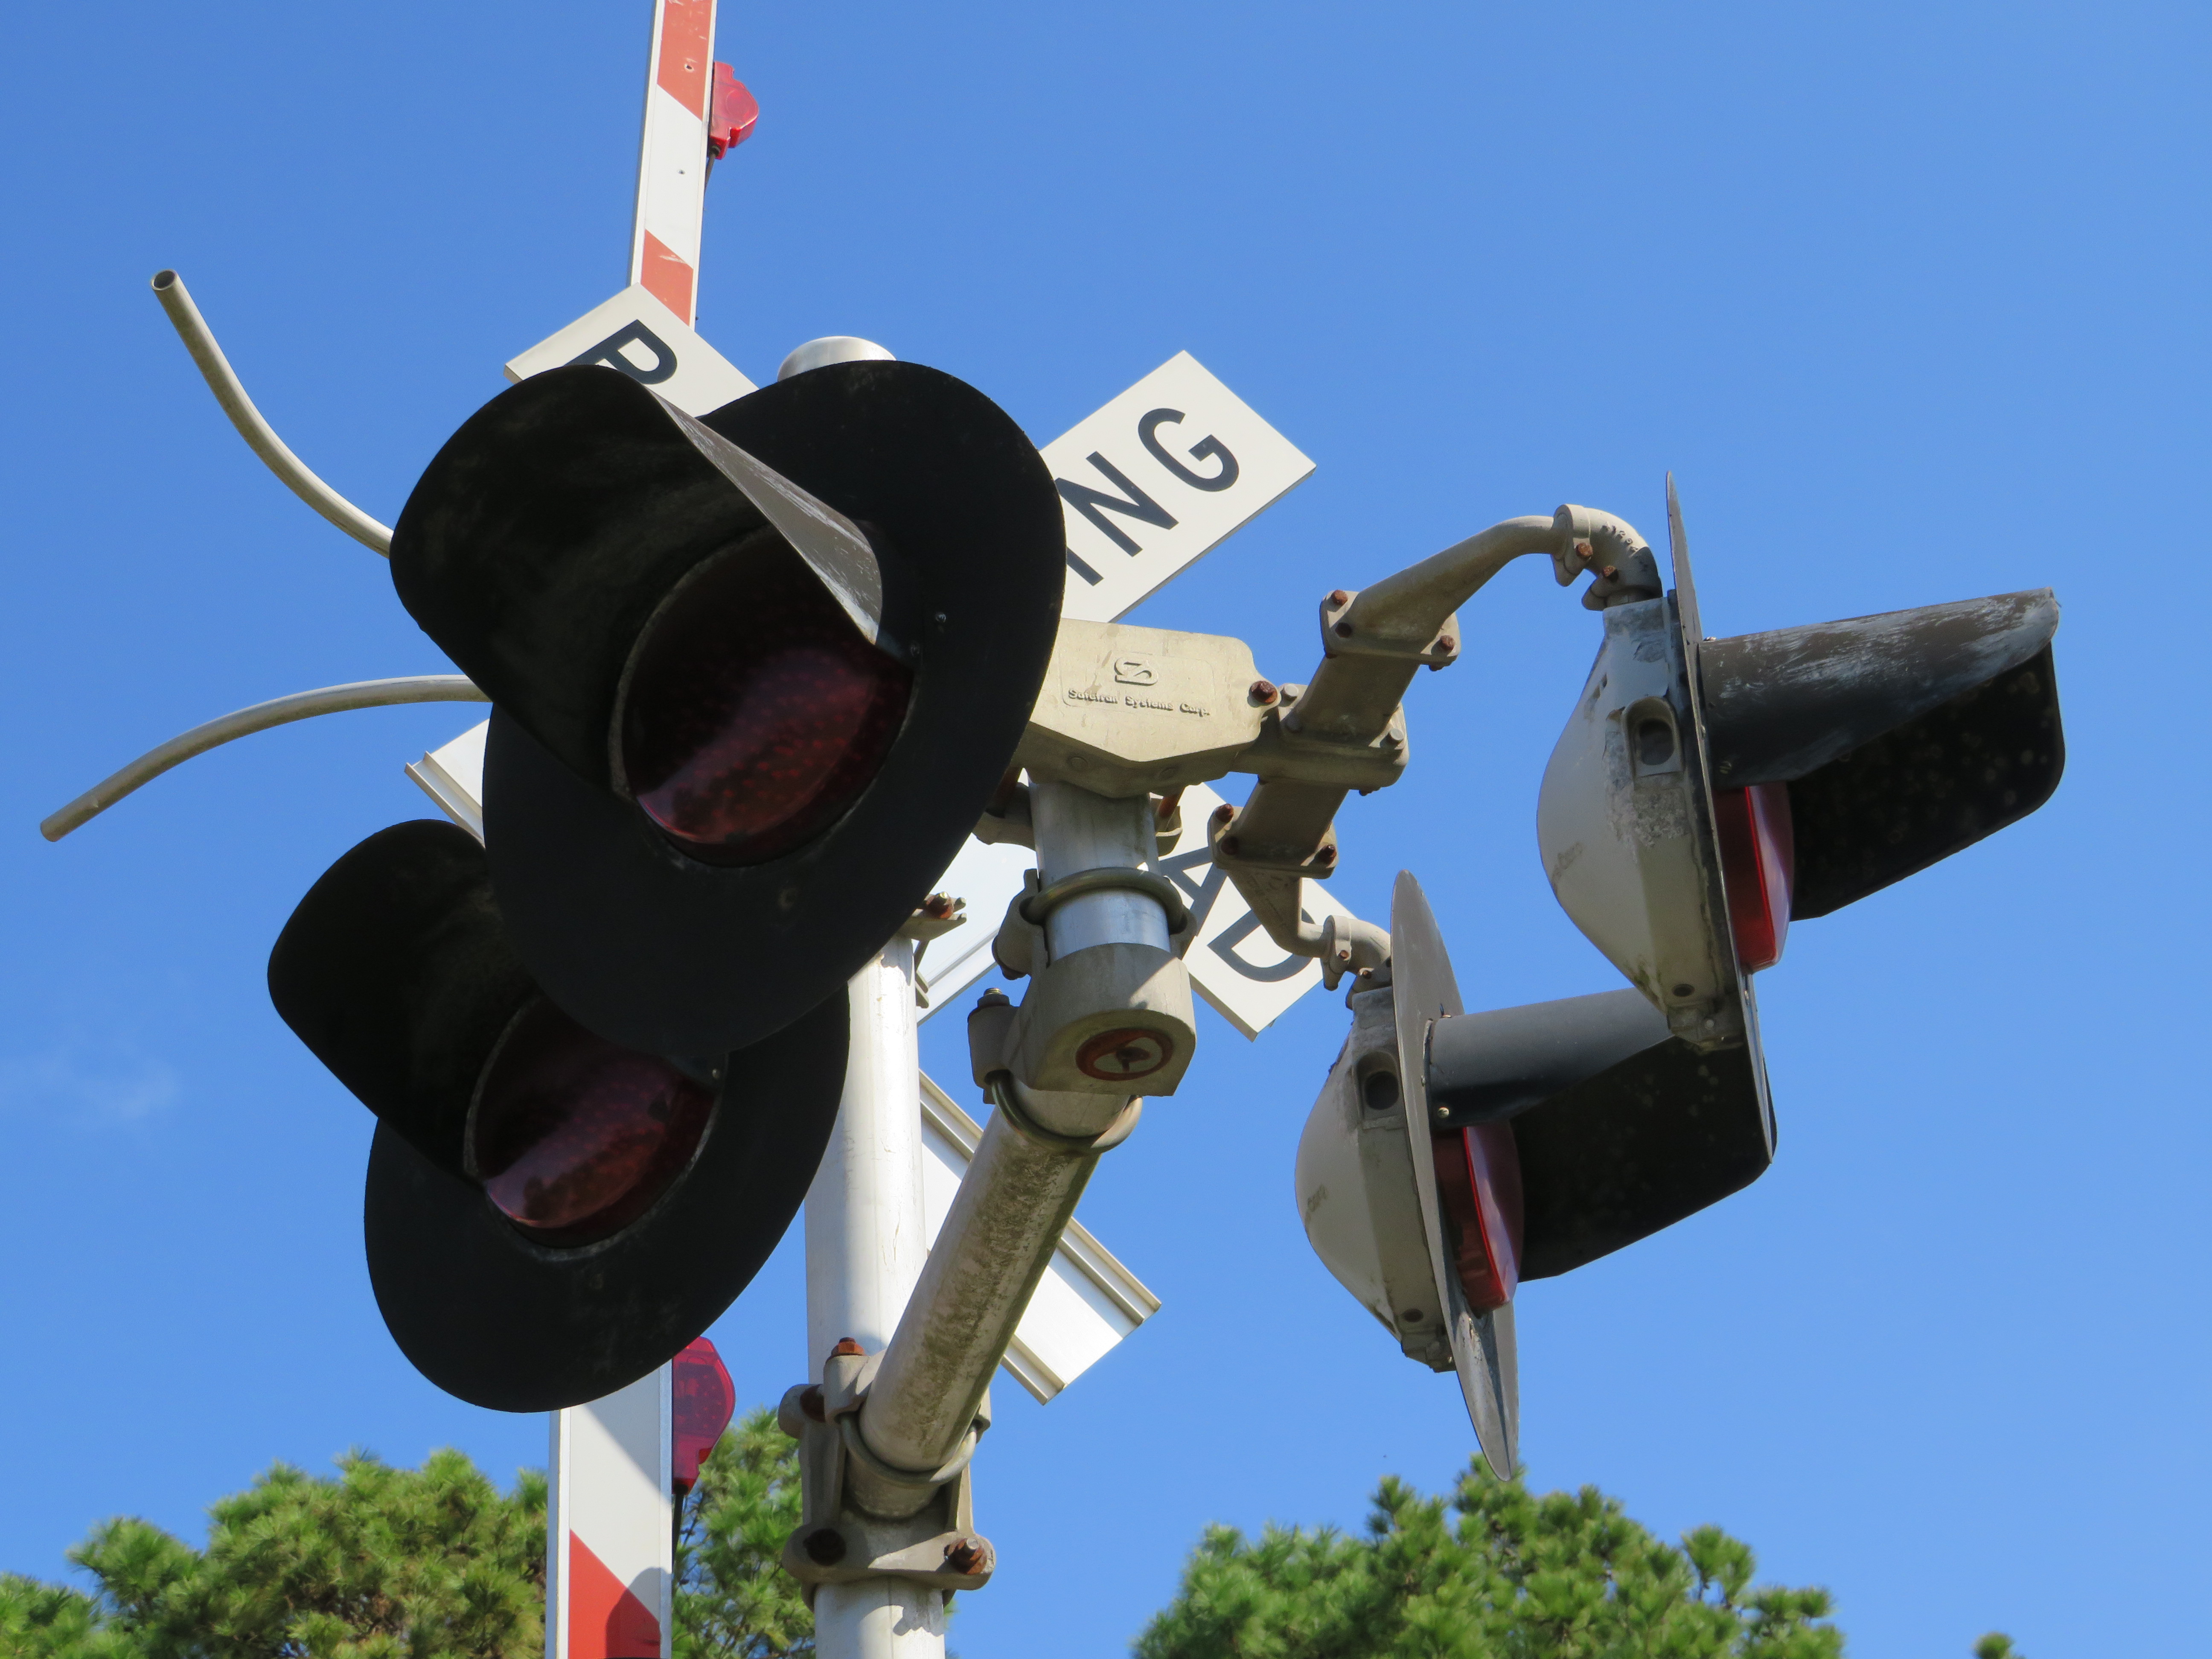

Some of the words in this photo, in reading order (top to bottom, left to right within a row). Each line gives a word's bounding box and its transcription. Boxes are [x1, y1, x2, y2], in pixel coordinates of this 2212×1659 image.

[1068, 687, 1118, 704] Safetran
[1125, 696, 1174, 711] Systems
[1179, 702, 1211, 717] Corp.
